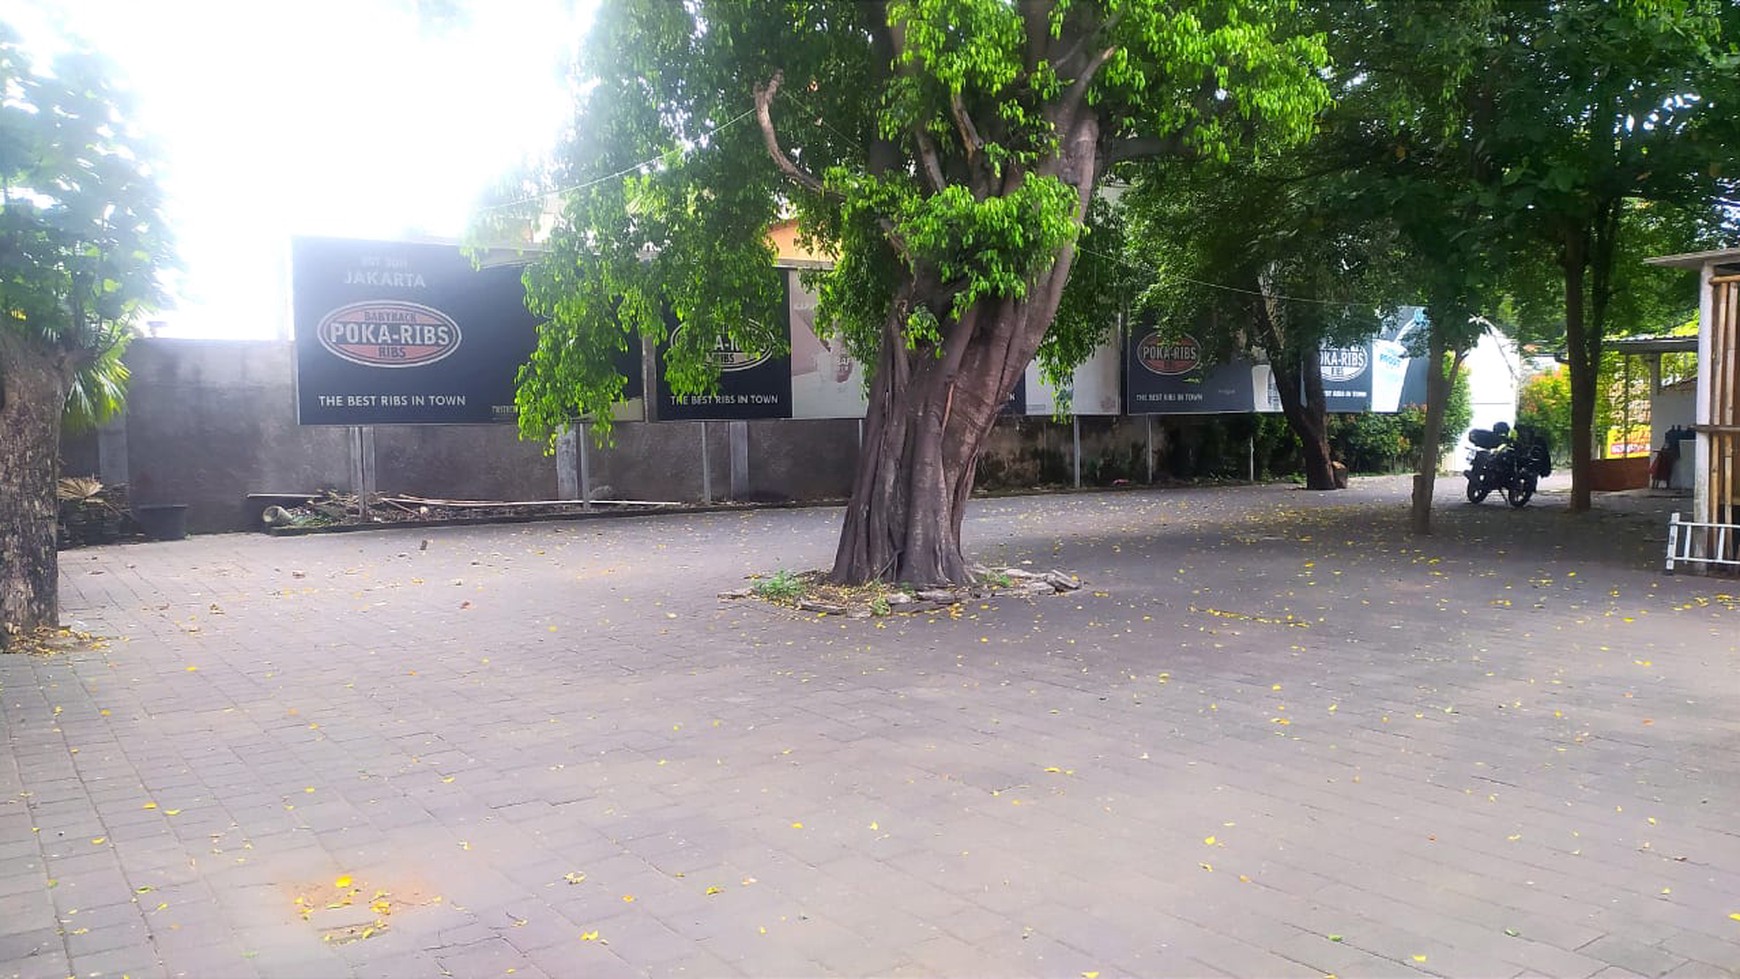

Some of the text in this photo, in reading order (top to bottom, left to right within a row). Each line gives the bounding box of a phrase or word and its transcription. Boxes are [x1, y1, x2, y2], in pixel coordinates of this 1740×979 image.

[343, 271, 426, 288] JAKARTA
[364, 312, 417, 323] BABYBACK
[329, 323, 450, 345] POKA-RIBS
[378, 346, 406, 358] RIBS
[1143, 346, 1197, 360] POKA-RIBS
[318, 395, 466, 406] THE BEST RIBS IN TOWN
[691, 395, 712, 405] BEST
[715, 395, 735, 404] RIBS
[737, 395, 748, 404] IN
[750, 395, 778, 404] TOWN
